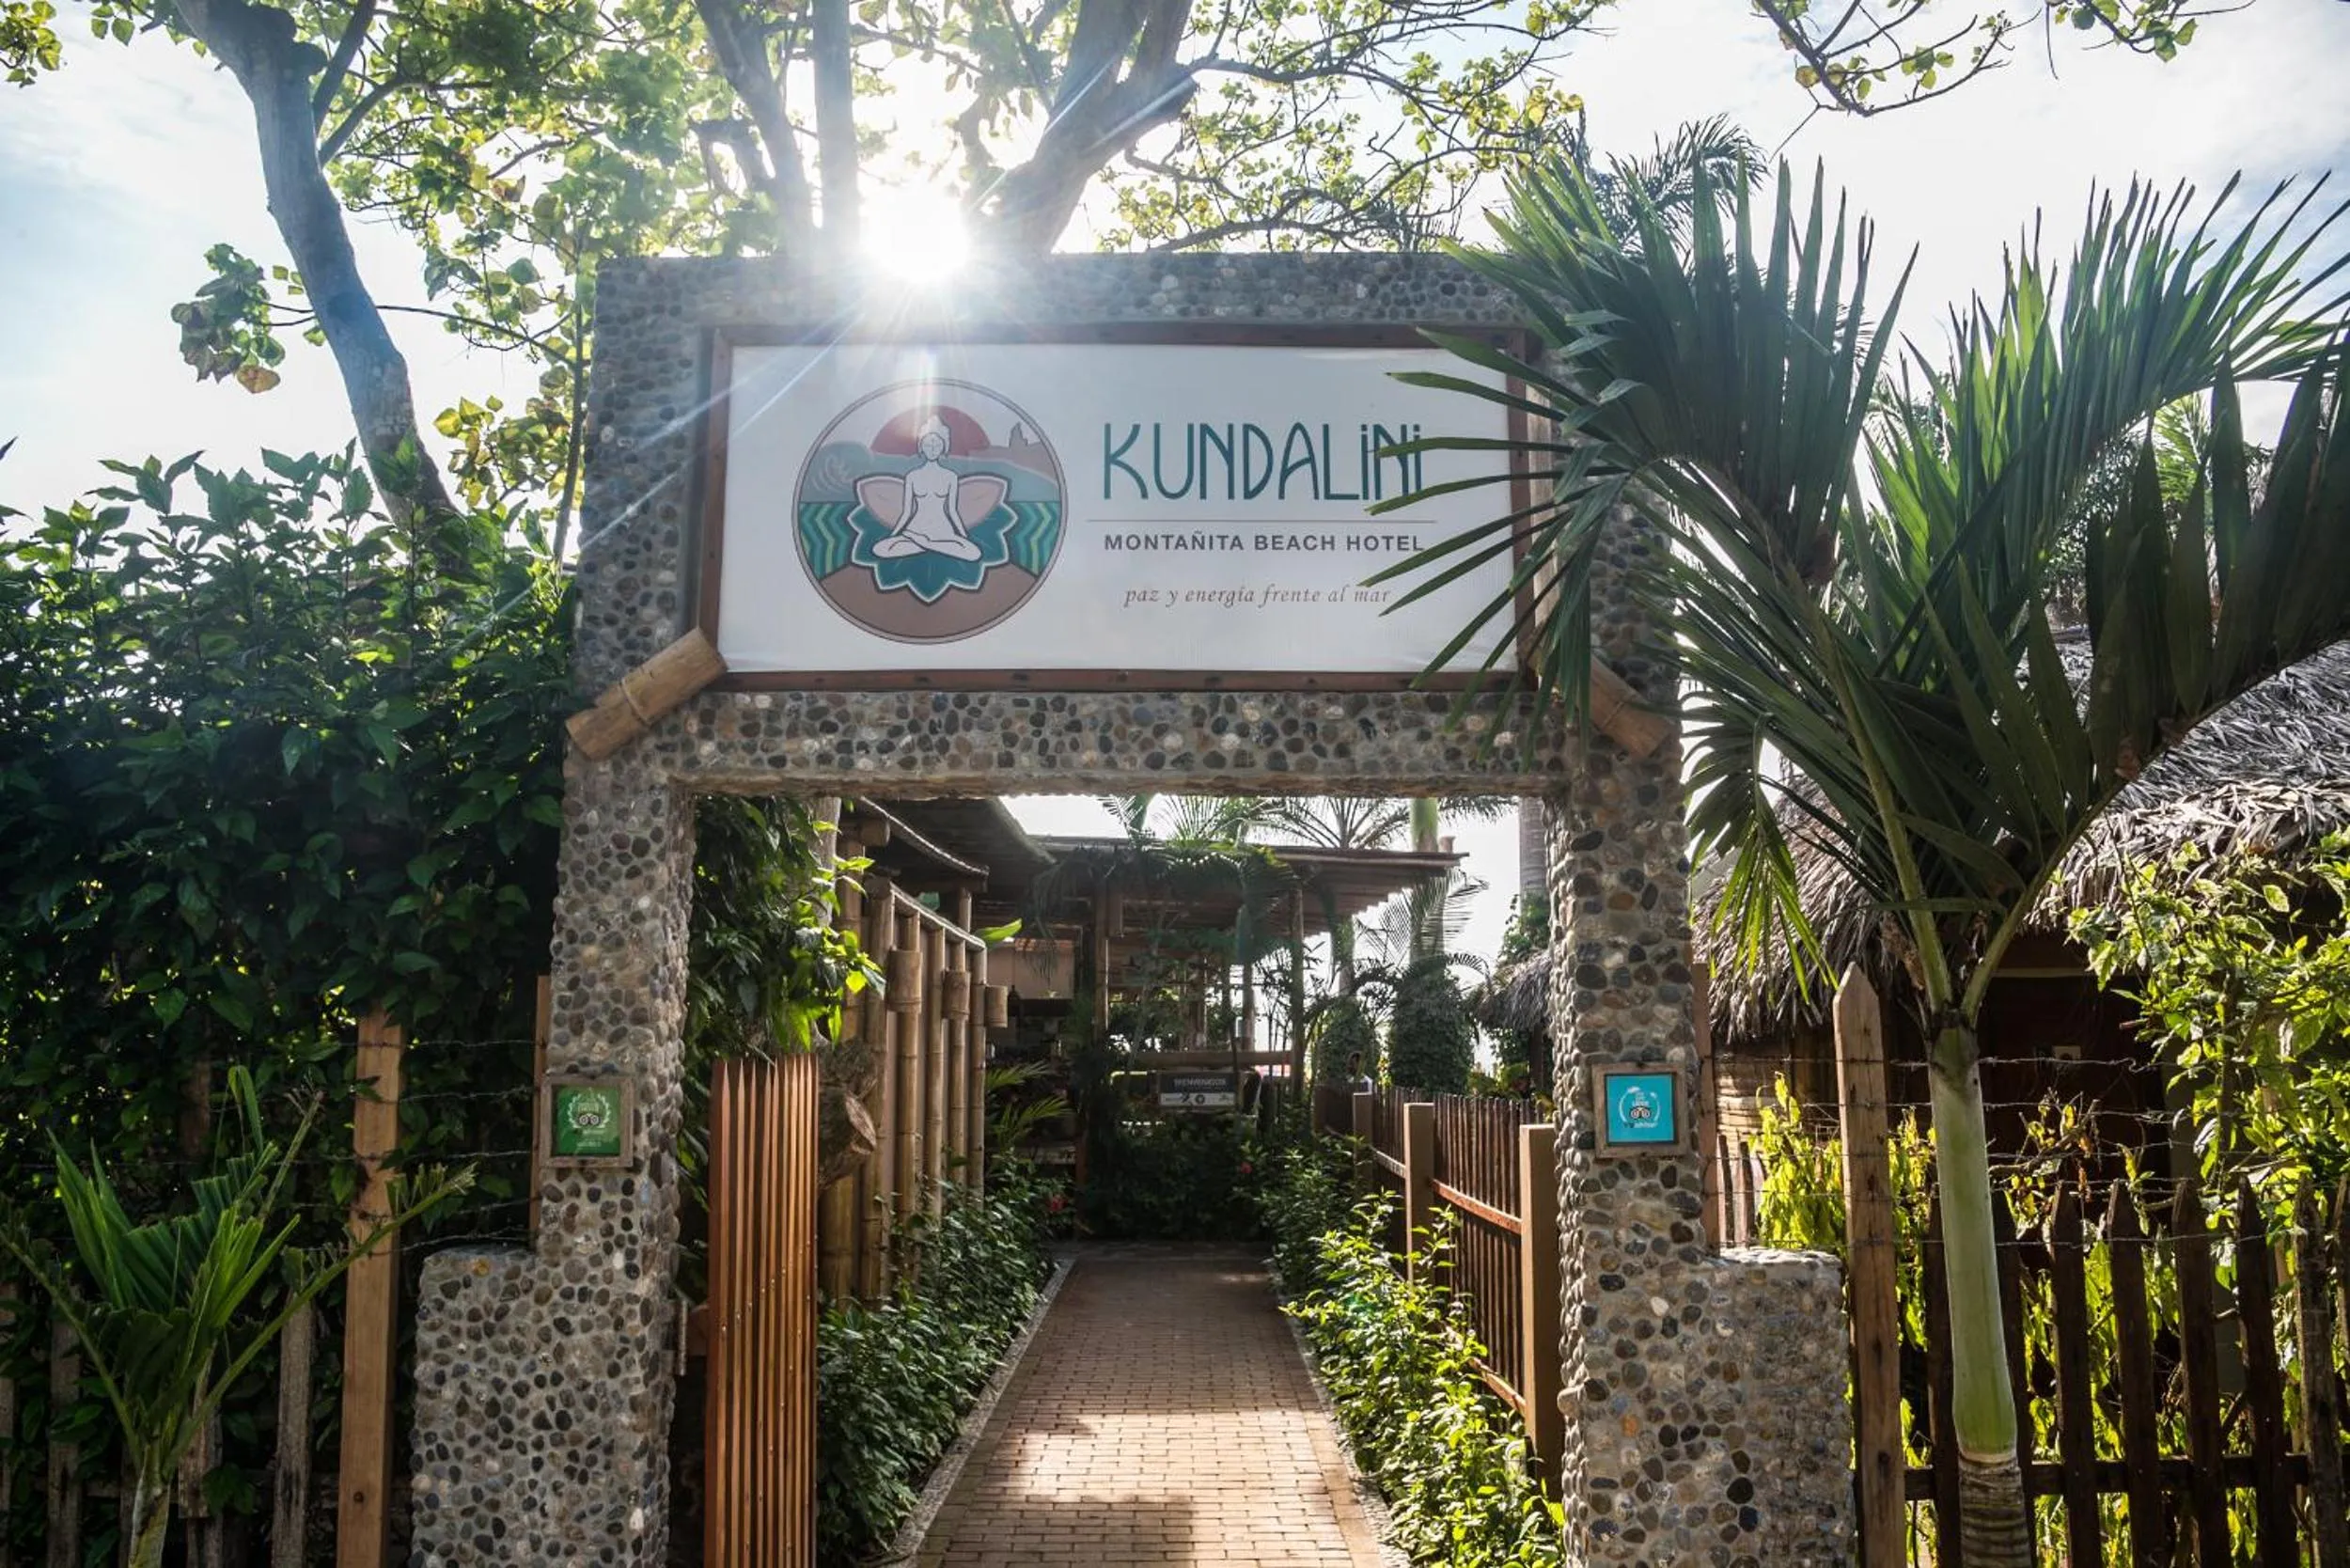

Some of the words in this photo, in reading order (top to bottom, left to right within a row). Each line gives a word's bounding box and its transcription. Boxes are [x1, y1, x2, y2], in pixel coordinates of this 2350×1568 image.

[1104, 530, 1245, 551] MONTAÑITA
[1254, 534, 1336, 551] BEACH
[1346, 535, 1425, 552] HOTEL
[1124, 588, 1160, 608] paz
[1166, 588, 1179, 607] y
[1184, 584, 1255, 607] energía
[1259, 584, 1321, 608] frente
[1327, 584, 1349, 603] al
[1354, 589, 1391, 603] mar
